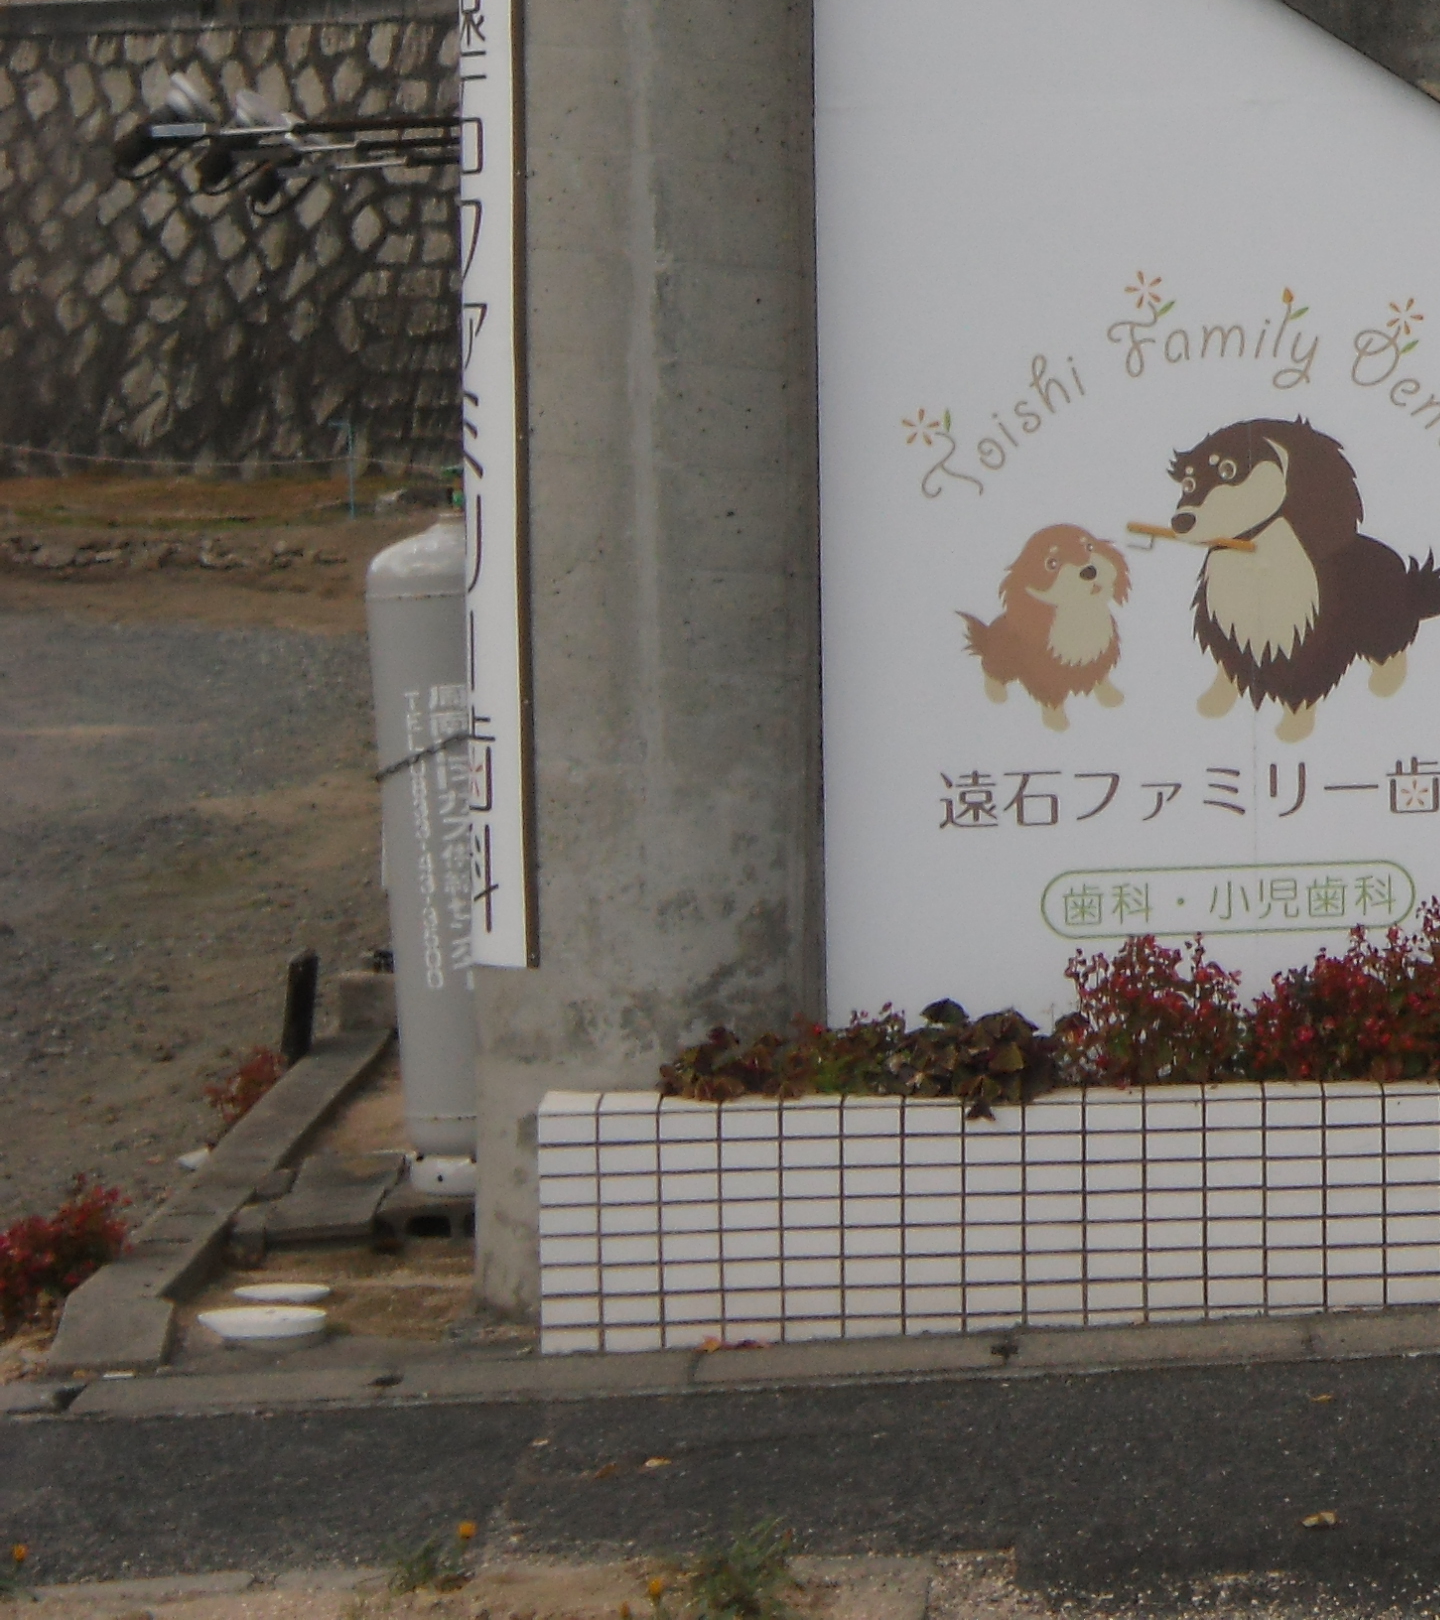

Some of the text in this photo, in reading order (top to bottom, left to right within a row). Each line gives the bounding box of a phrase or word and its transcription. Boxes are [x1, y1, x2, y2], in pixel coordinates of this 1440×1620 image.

[1107, 300, 1320, 390] Family
[1061, 876, 1397, 927] 歯科・小児歯科
